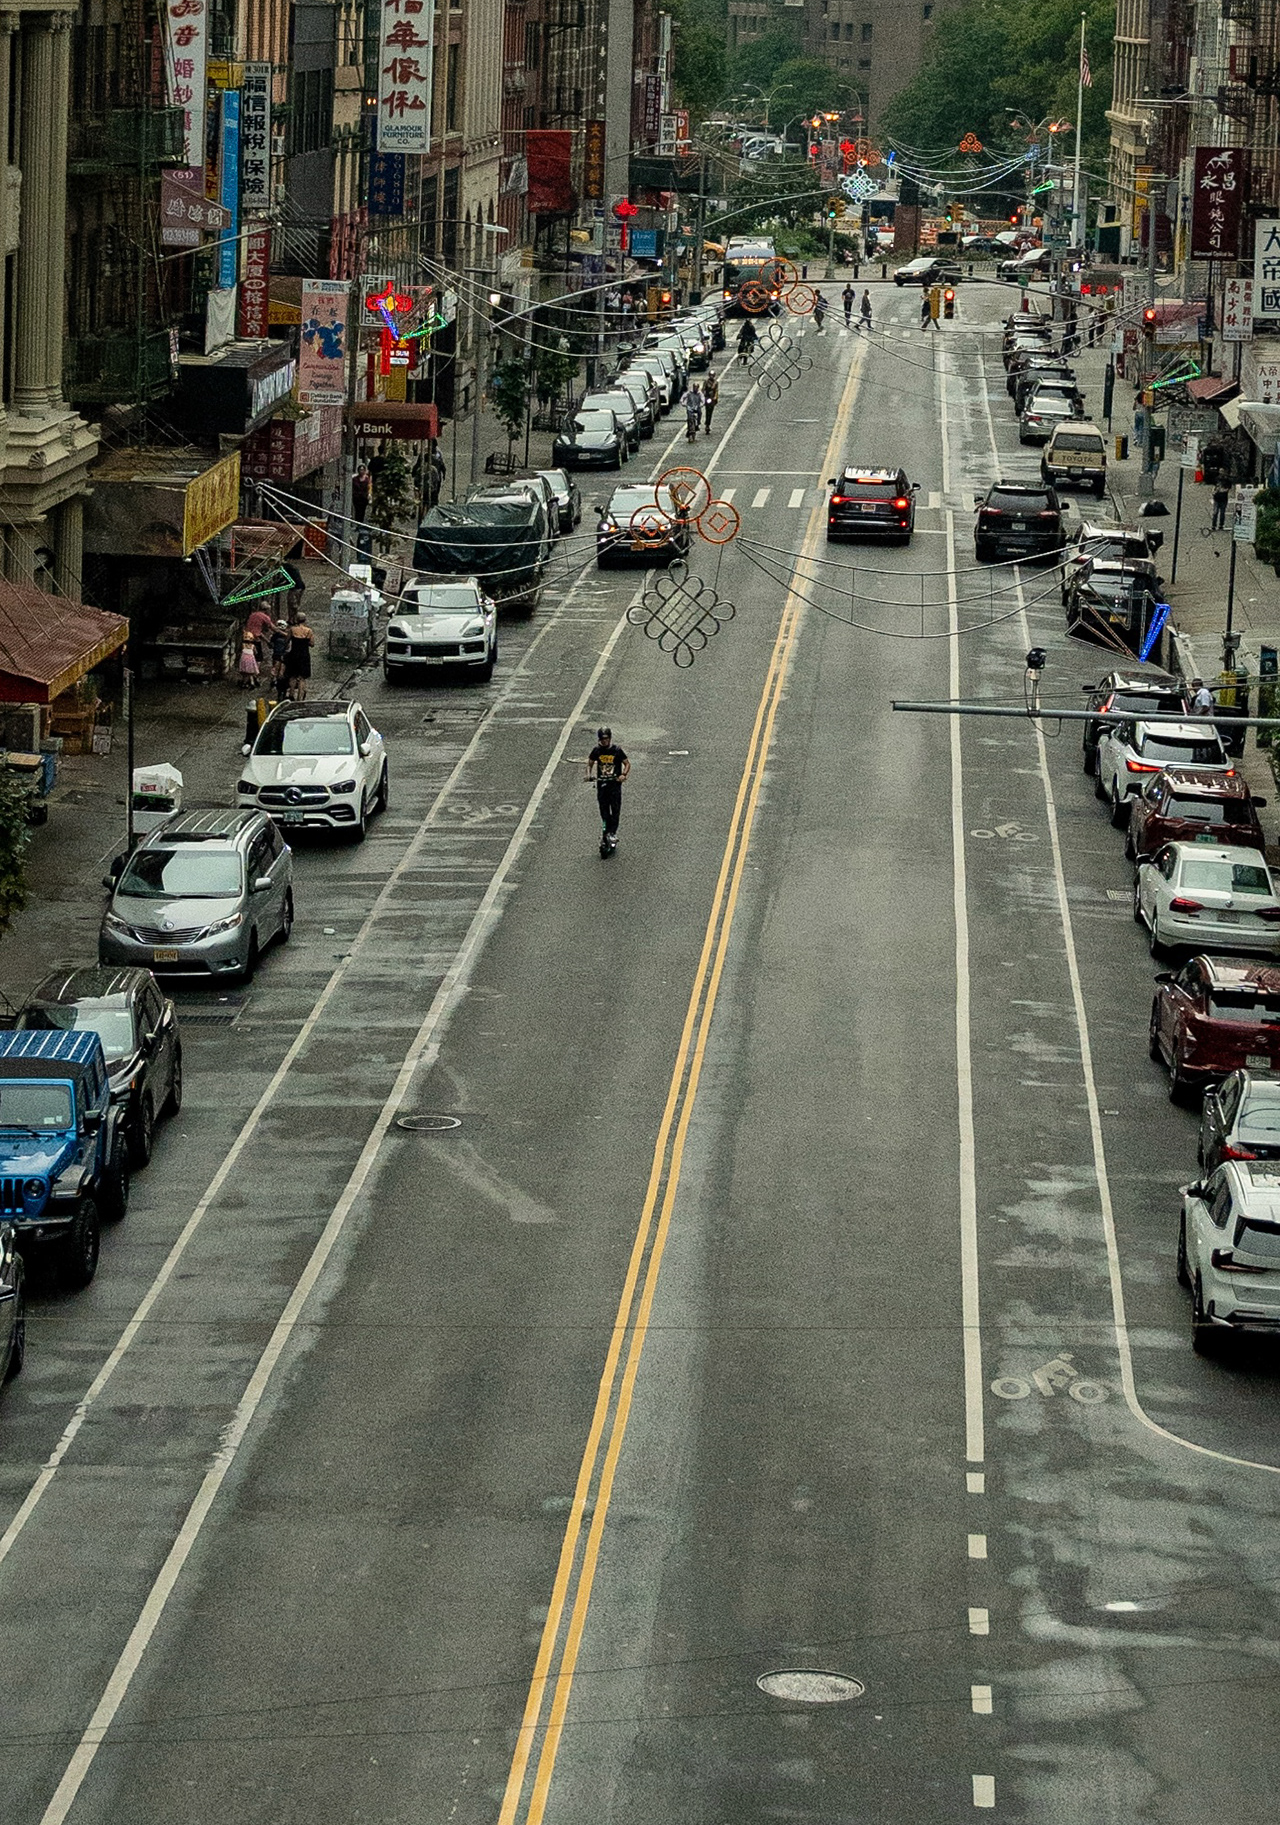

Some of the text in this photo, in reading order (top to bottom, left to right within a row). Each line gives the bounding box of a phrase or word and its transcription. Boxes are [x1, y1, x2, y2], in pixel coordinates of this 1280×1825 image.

[382, 131, 425, 139] FURNITURE
[363, 422, 393, 435] Bank
[1061, 455, 1093, 463] TOYOTA
